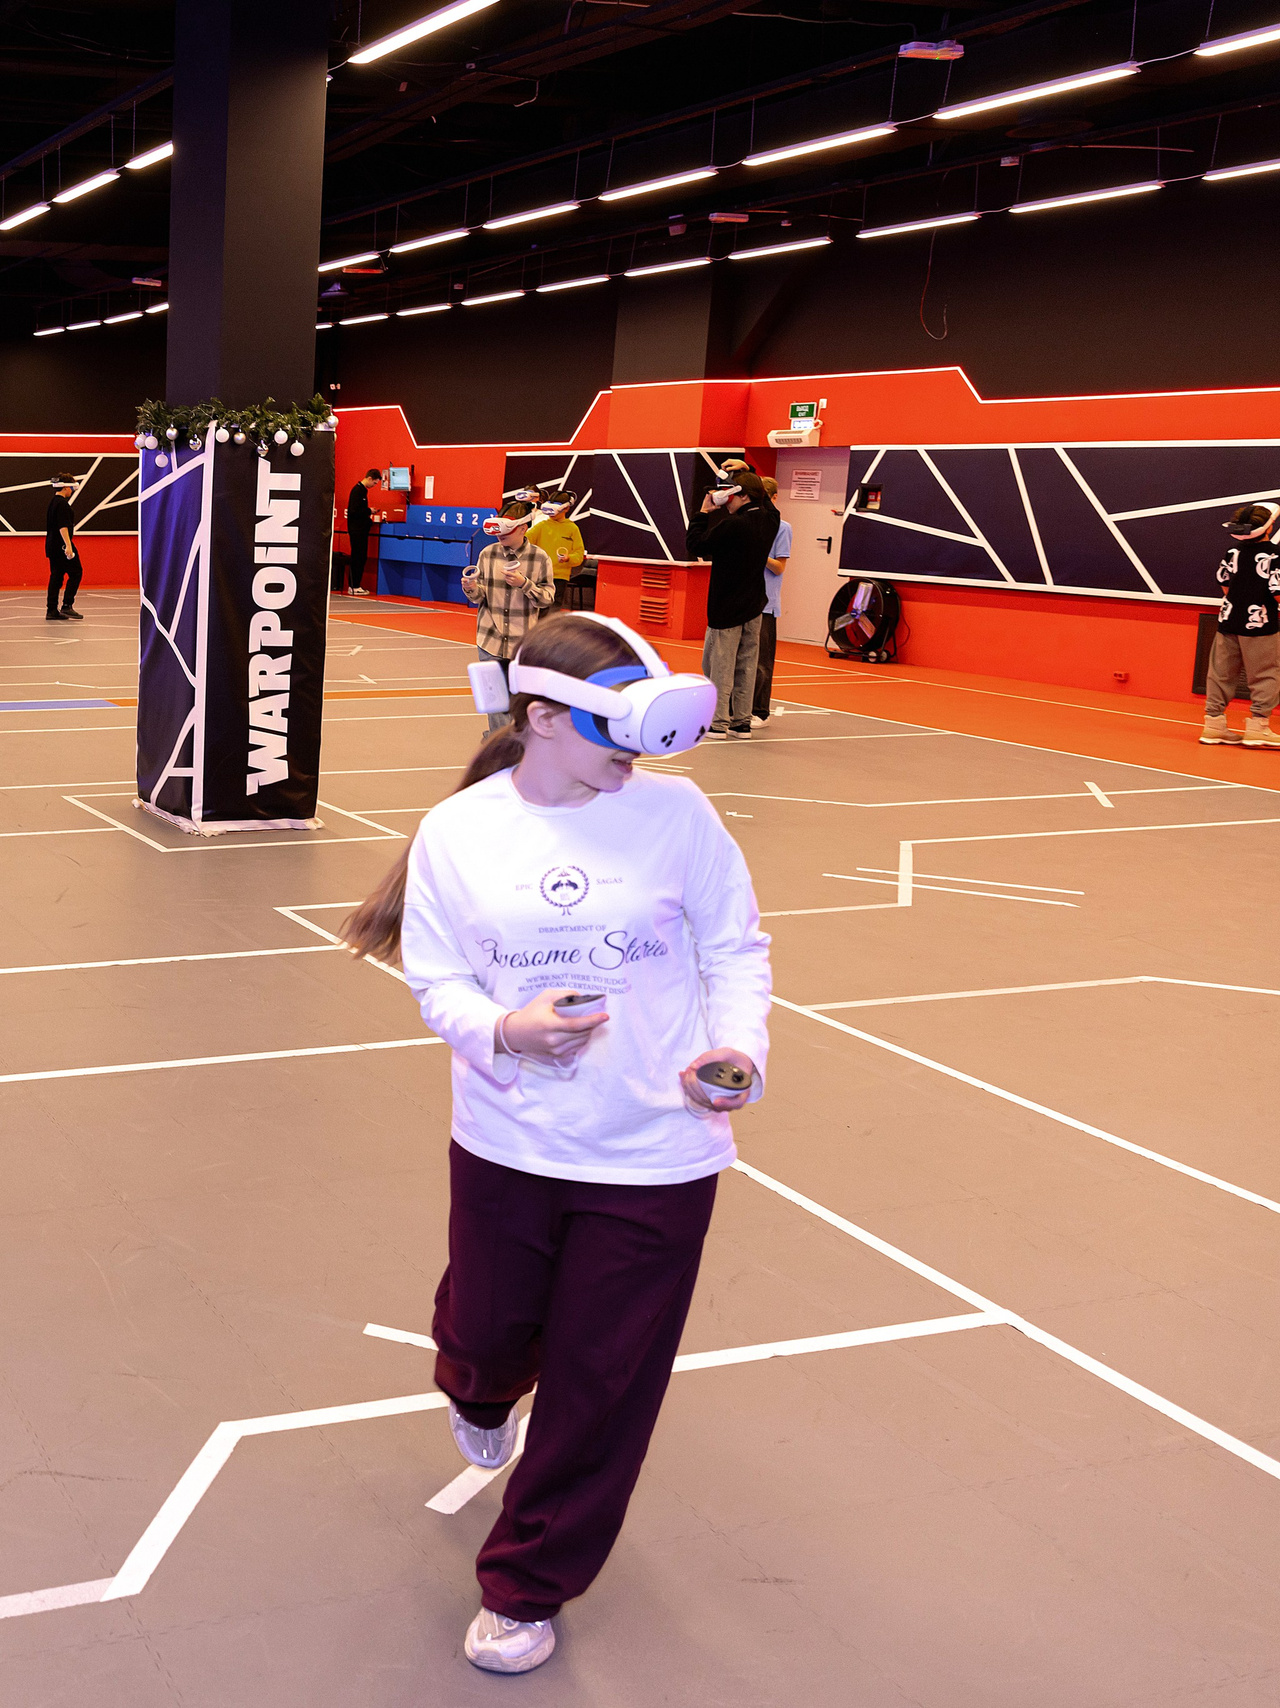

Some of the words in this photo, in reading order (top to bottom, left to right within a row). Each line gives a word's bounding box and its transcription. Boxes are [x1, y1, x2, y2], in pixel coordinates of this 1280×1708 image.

[425, 511, 432, 523] 5
[440, 512, 446, 524] 4
[456, 512, 463, 525] 3
[471, 513, 479, 526] 2
[246, 457, 301, 796] WARPOINT
[596, 877, 623, 885] SAGAS
[538, 925, 593, 934] DEPARTMENT
[595, 924, 607, 932] OF
[475, 938, 582, 968] Awesome
[589, 931, 669, 970] Stories
[525, 974, 550, 984] WE'RE
[552, 973, 569, 981] NOT
[571, 973, 591, 982] HERE
[592, 975, 603, 984] TO
[517, 985, 534, 993] BUT
[549, 981, 567, 989] CAN
[568, 982, 608, 993] CERTAINLY
